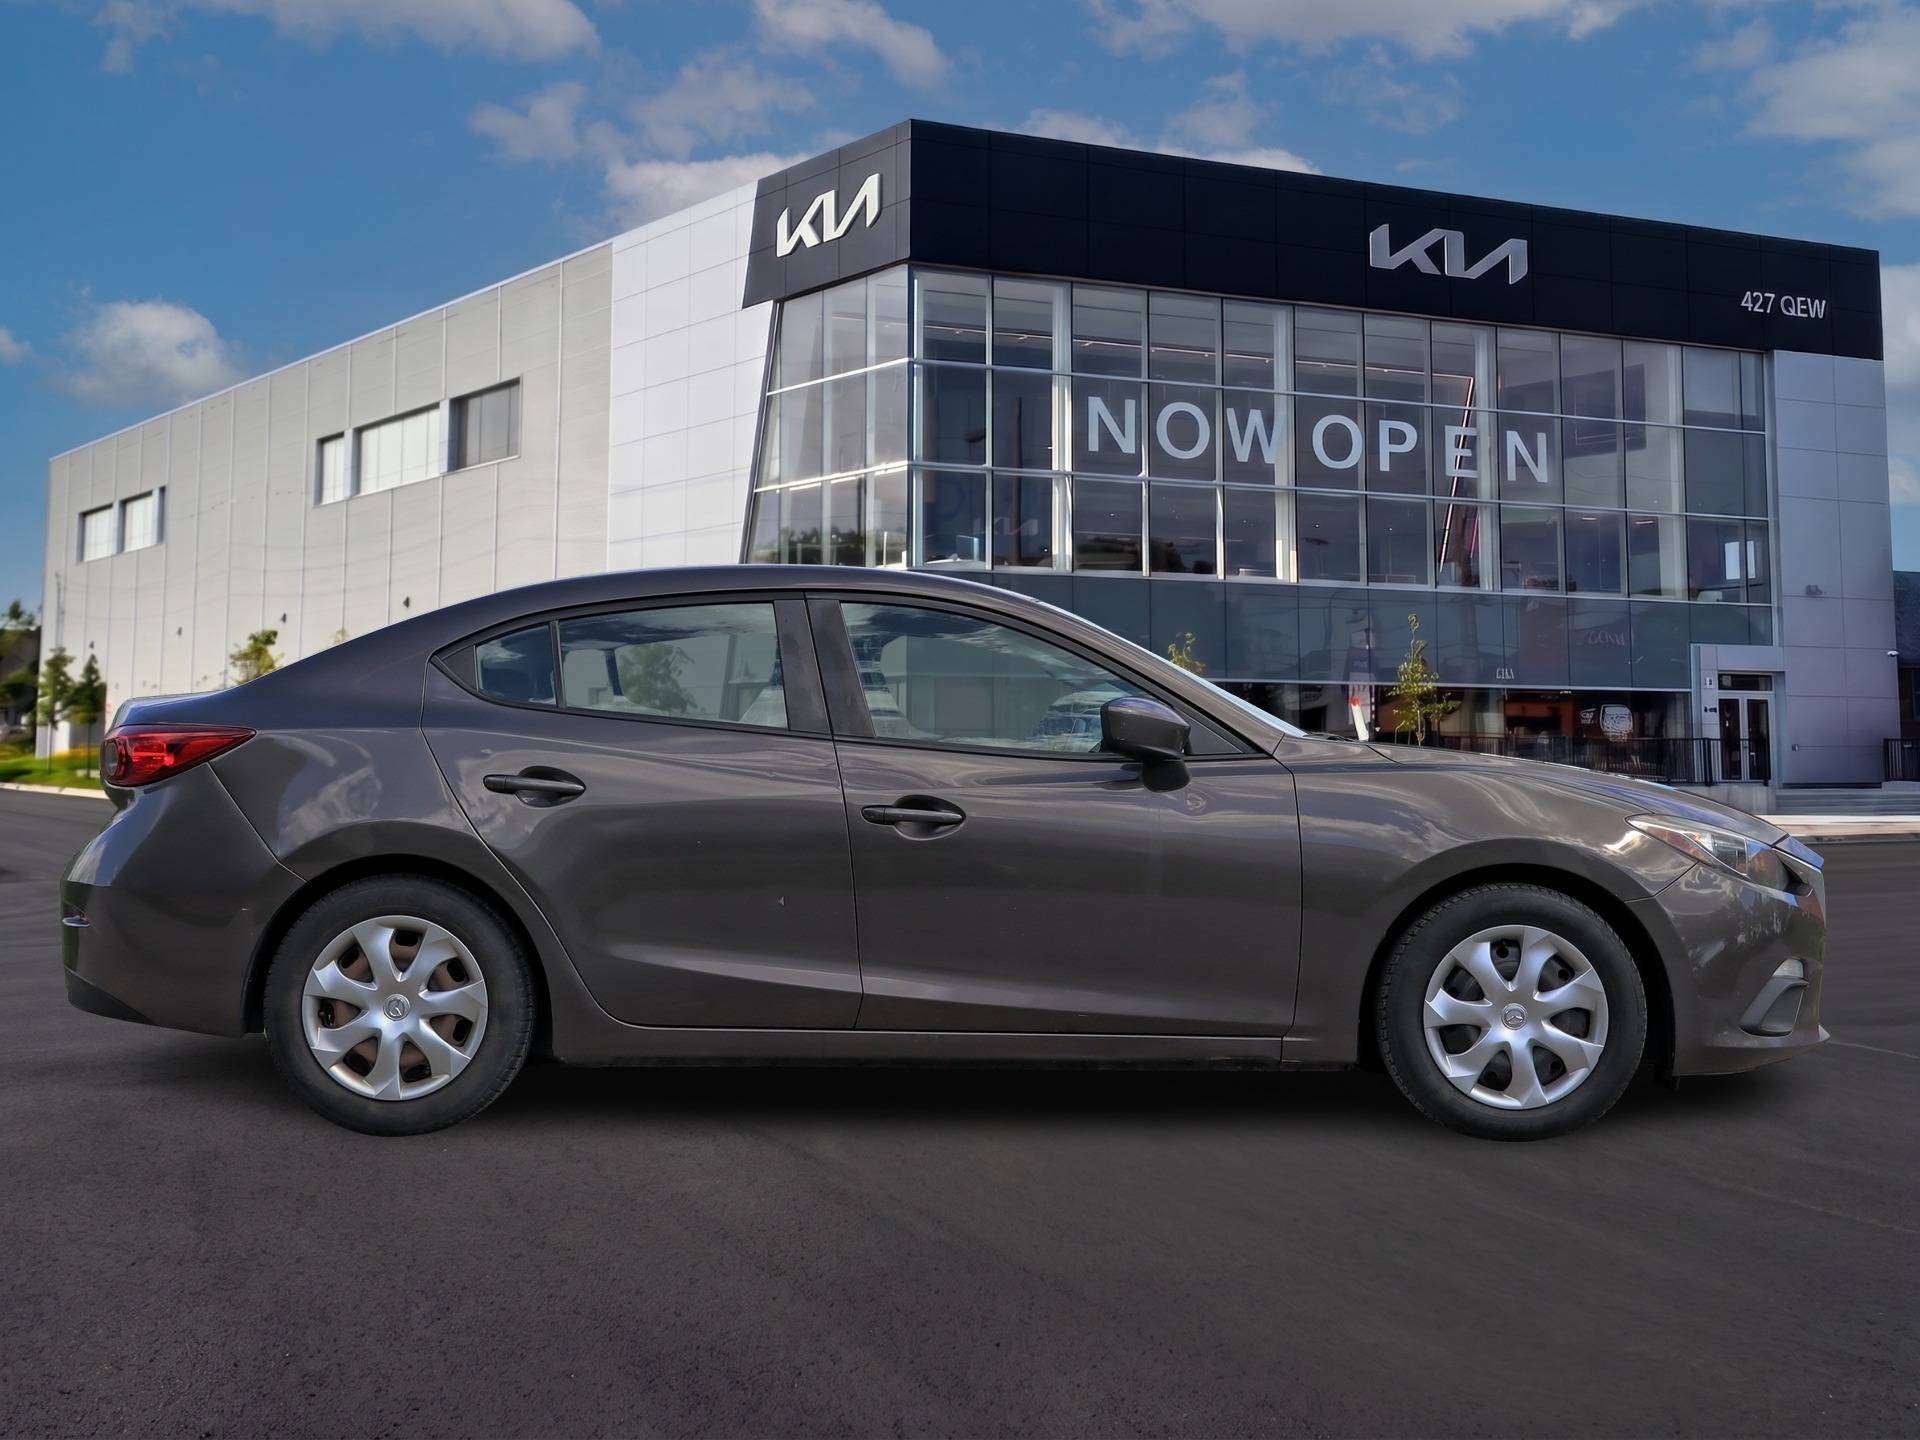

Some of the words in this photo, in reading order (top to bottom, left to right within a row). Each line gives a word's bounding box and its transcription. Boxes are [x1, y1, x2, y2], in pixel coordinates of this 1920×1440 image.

[776, 173, 880, 258] KIA
[1369, 223, 1528, 285] KIA
[1740, 291, 1776, 314] 427
[1780, 295, 1826, 319] QEW
[1087, 396, 1284, 464] NOW
[1312, 414, 1549, 484] OPEN
